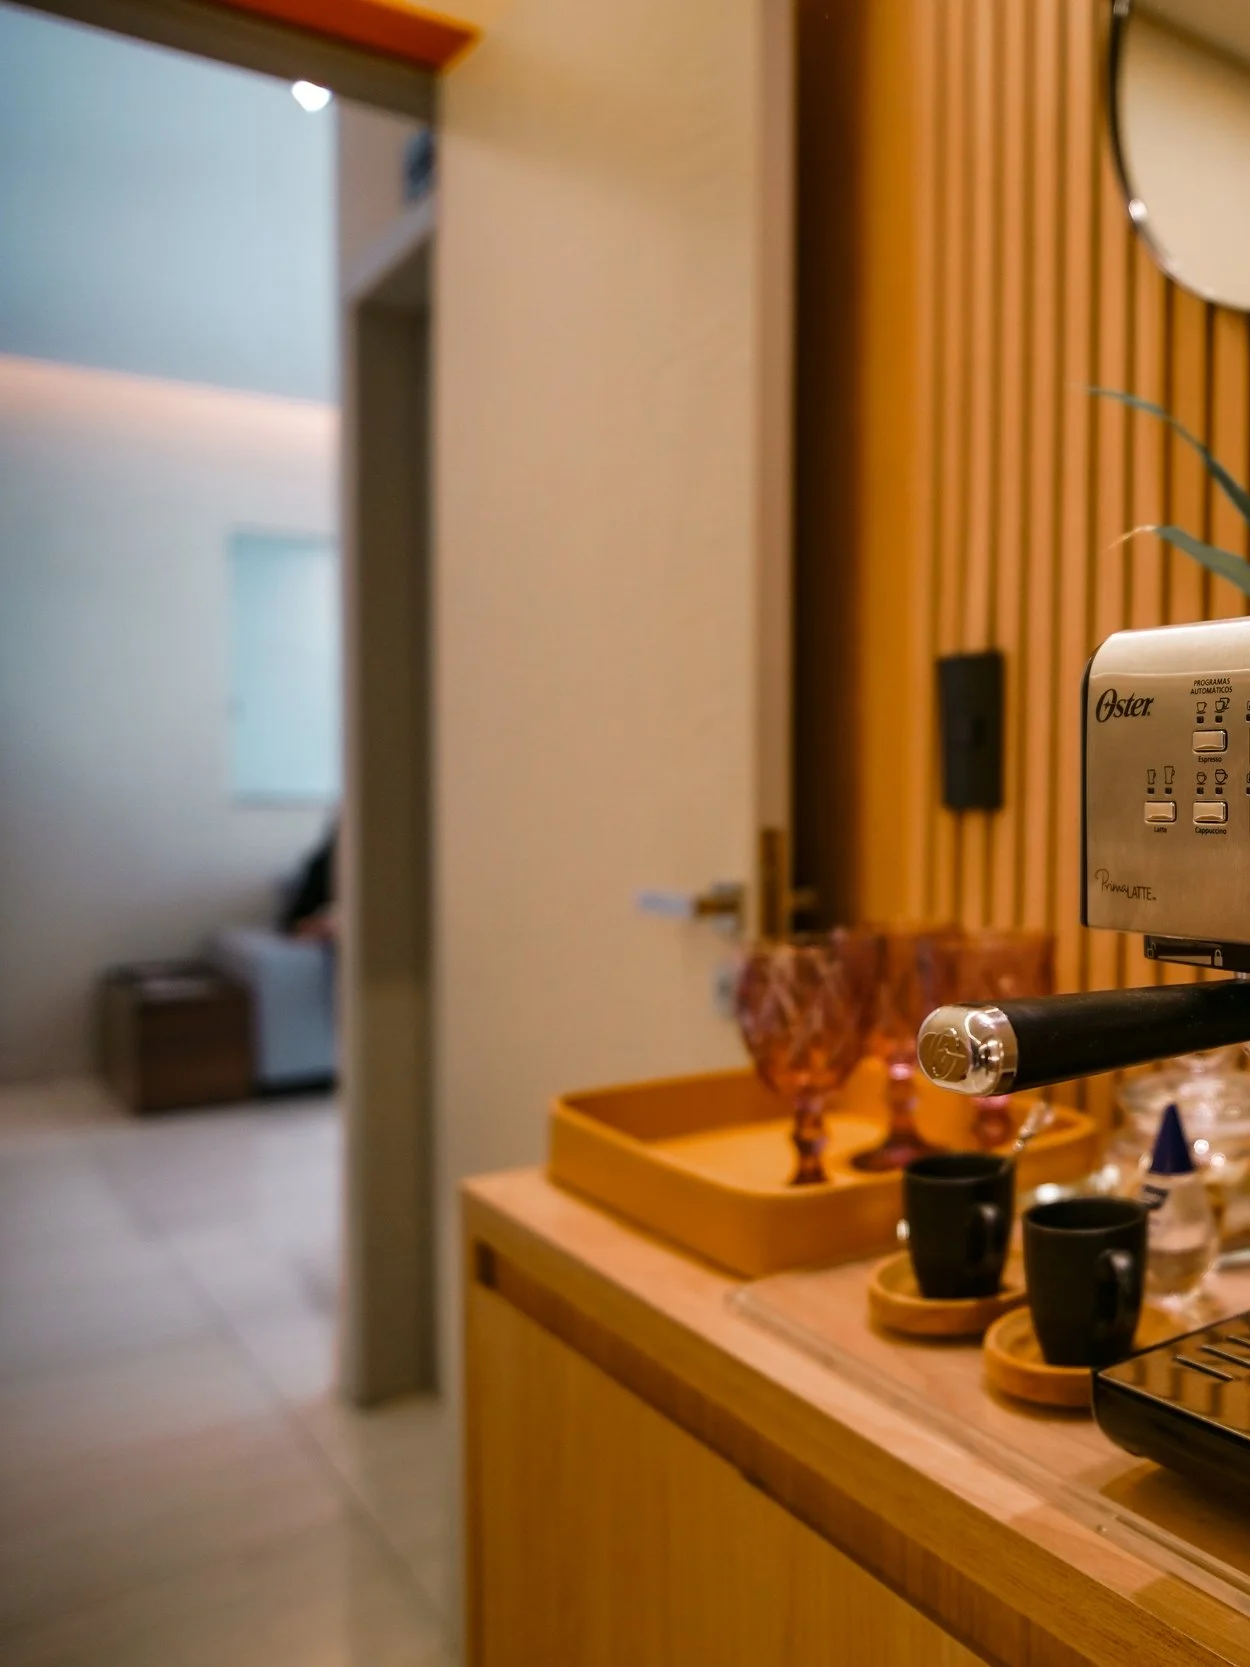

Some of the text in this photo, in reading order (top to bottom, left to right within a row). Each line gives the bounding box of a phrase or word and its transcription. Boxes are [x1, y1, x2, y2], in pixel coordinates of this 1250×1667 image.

[1193, 678, 1231, 686] PROGRAMAS
[1190, 685, 1233, 695] AUTOMÁTICOS
[1095, 688, 1154, 723] Oster
[1195, 827, 1227, 835] Cappuccino
